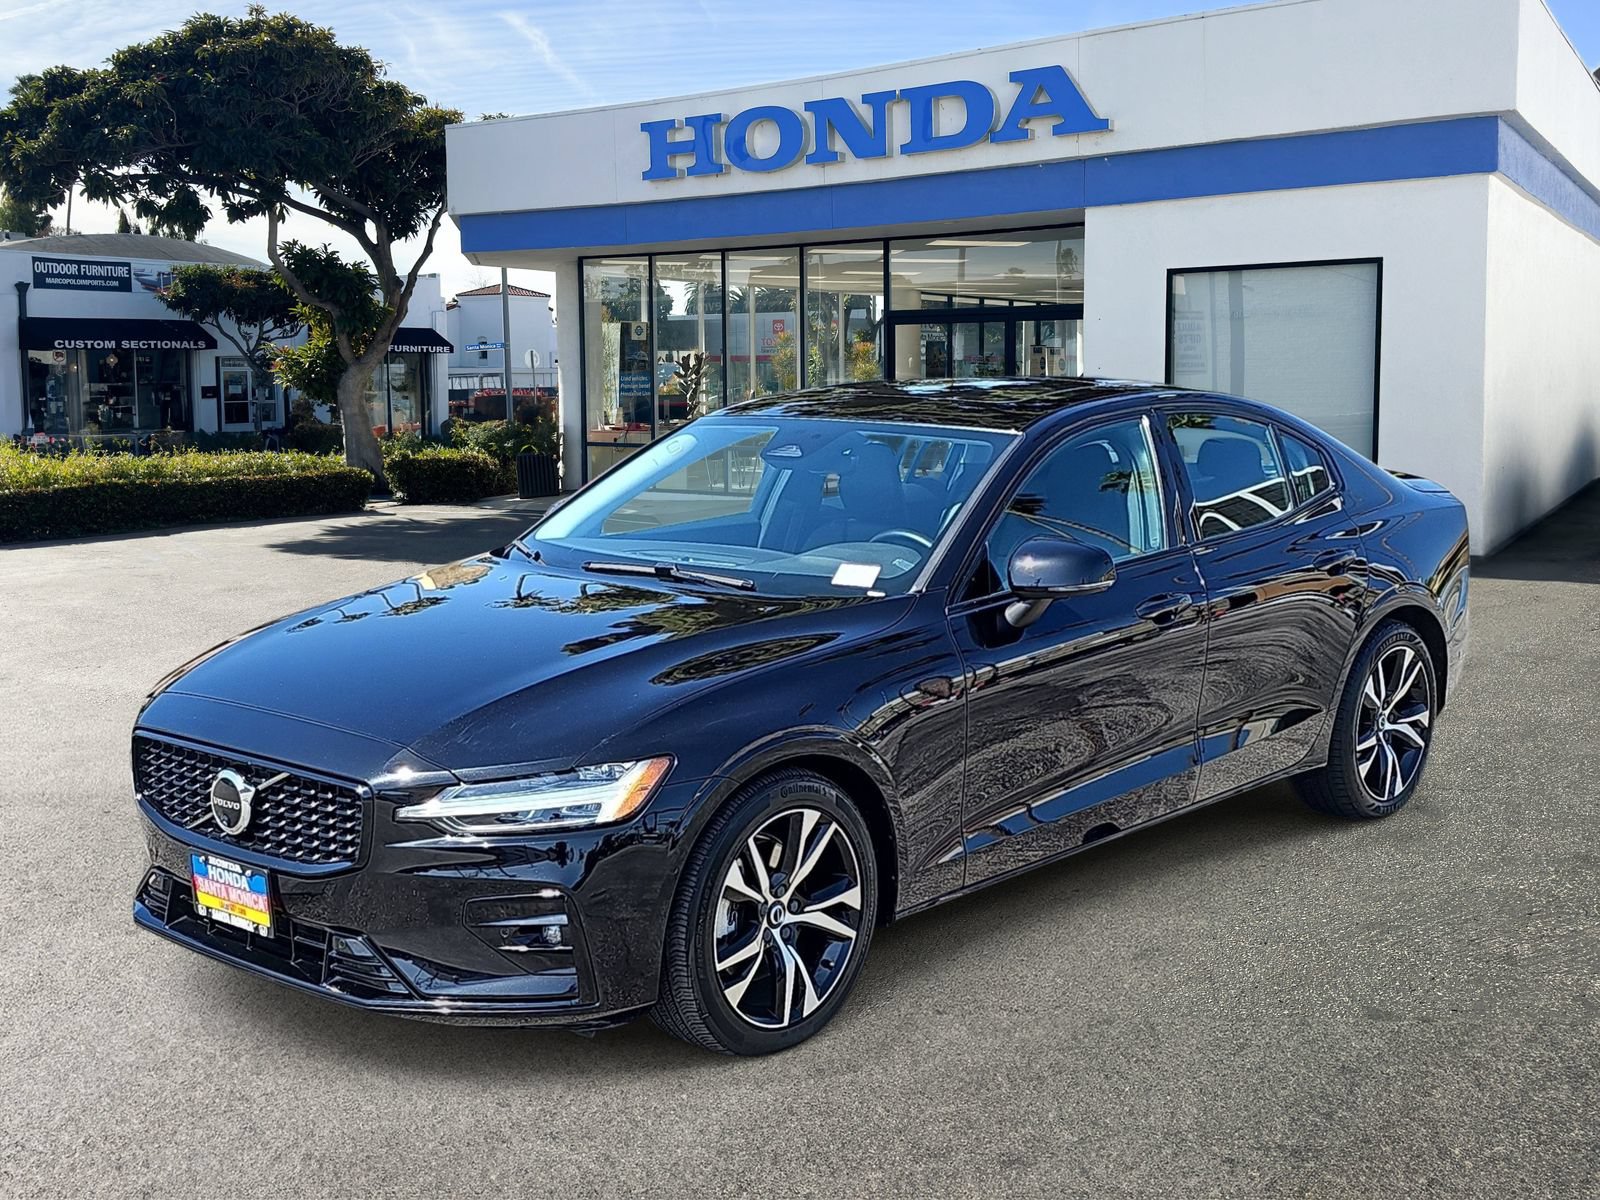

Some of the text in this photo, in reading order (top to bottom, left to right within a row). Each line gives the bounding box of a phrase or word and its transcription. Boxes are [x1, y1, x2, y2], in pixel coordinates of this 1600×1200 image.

[640, 64, 1112, 182] HONDA
[34, 261, 130, 278] OUTDOOR FURNITURE
[45, 277, 120, 287] MARCOPOLOIMPORTS.COM
[54, 339, 206, 349] CUSTOM SECTIONALS
[388, 345, 451, 353] FURNITURE
[780, 783, 822, 798] Continental
[213, 796, 240, 810] VOLVO
[206, 864, 251, 892] HONDA
[198, 878, 228, 901] SANTA
[228, 886, 269, 914] MONICA
